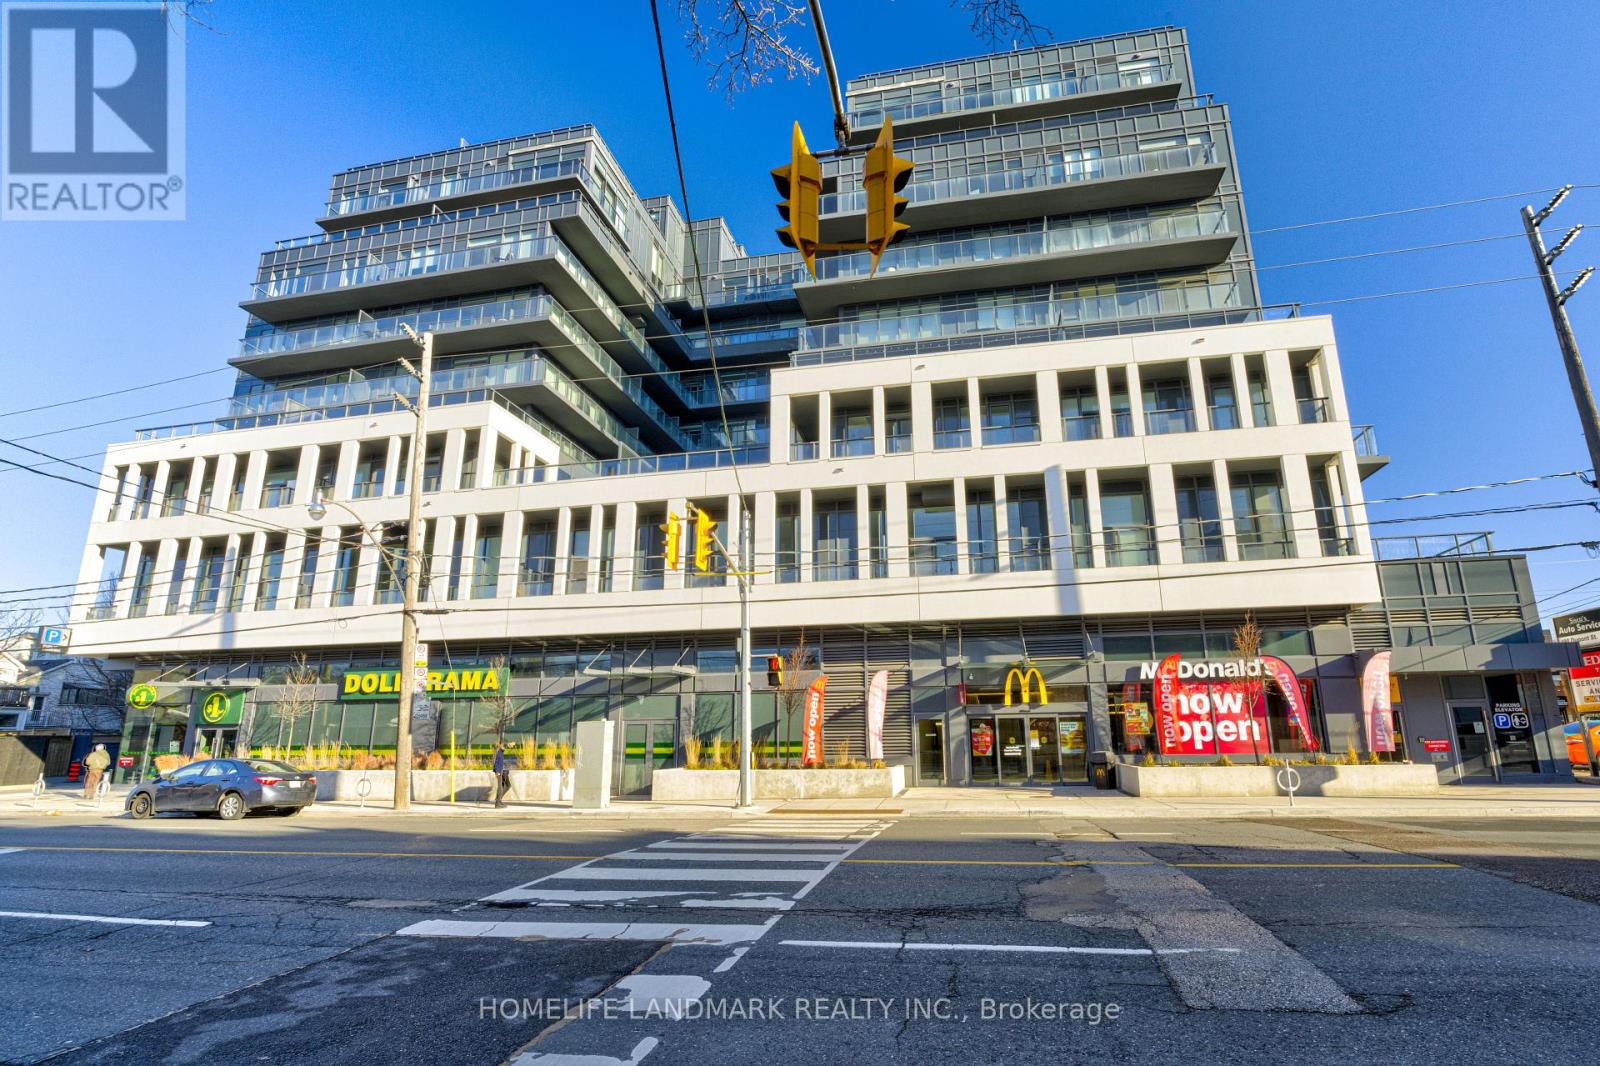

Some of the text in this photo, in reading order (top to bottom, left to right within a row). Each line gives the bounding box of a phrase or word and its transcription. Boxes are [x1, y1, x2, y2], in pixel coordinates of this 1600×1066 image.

[48, 630, 59, 642] P
[1559, 626, 1576, 635] Auto
[1583, 655, 1600, 666] ED
[344, 670, 500, 694] DOLLRAMA
[1576, 679, 1600, 687] SERVI
[1160, 674, 1176, 748] now open
[807, 692, 820, 758] now open
[1498, 715, 1507, 726] P
